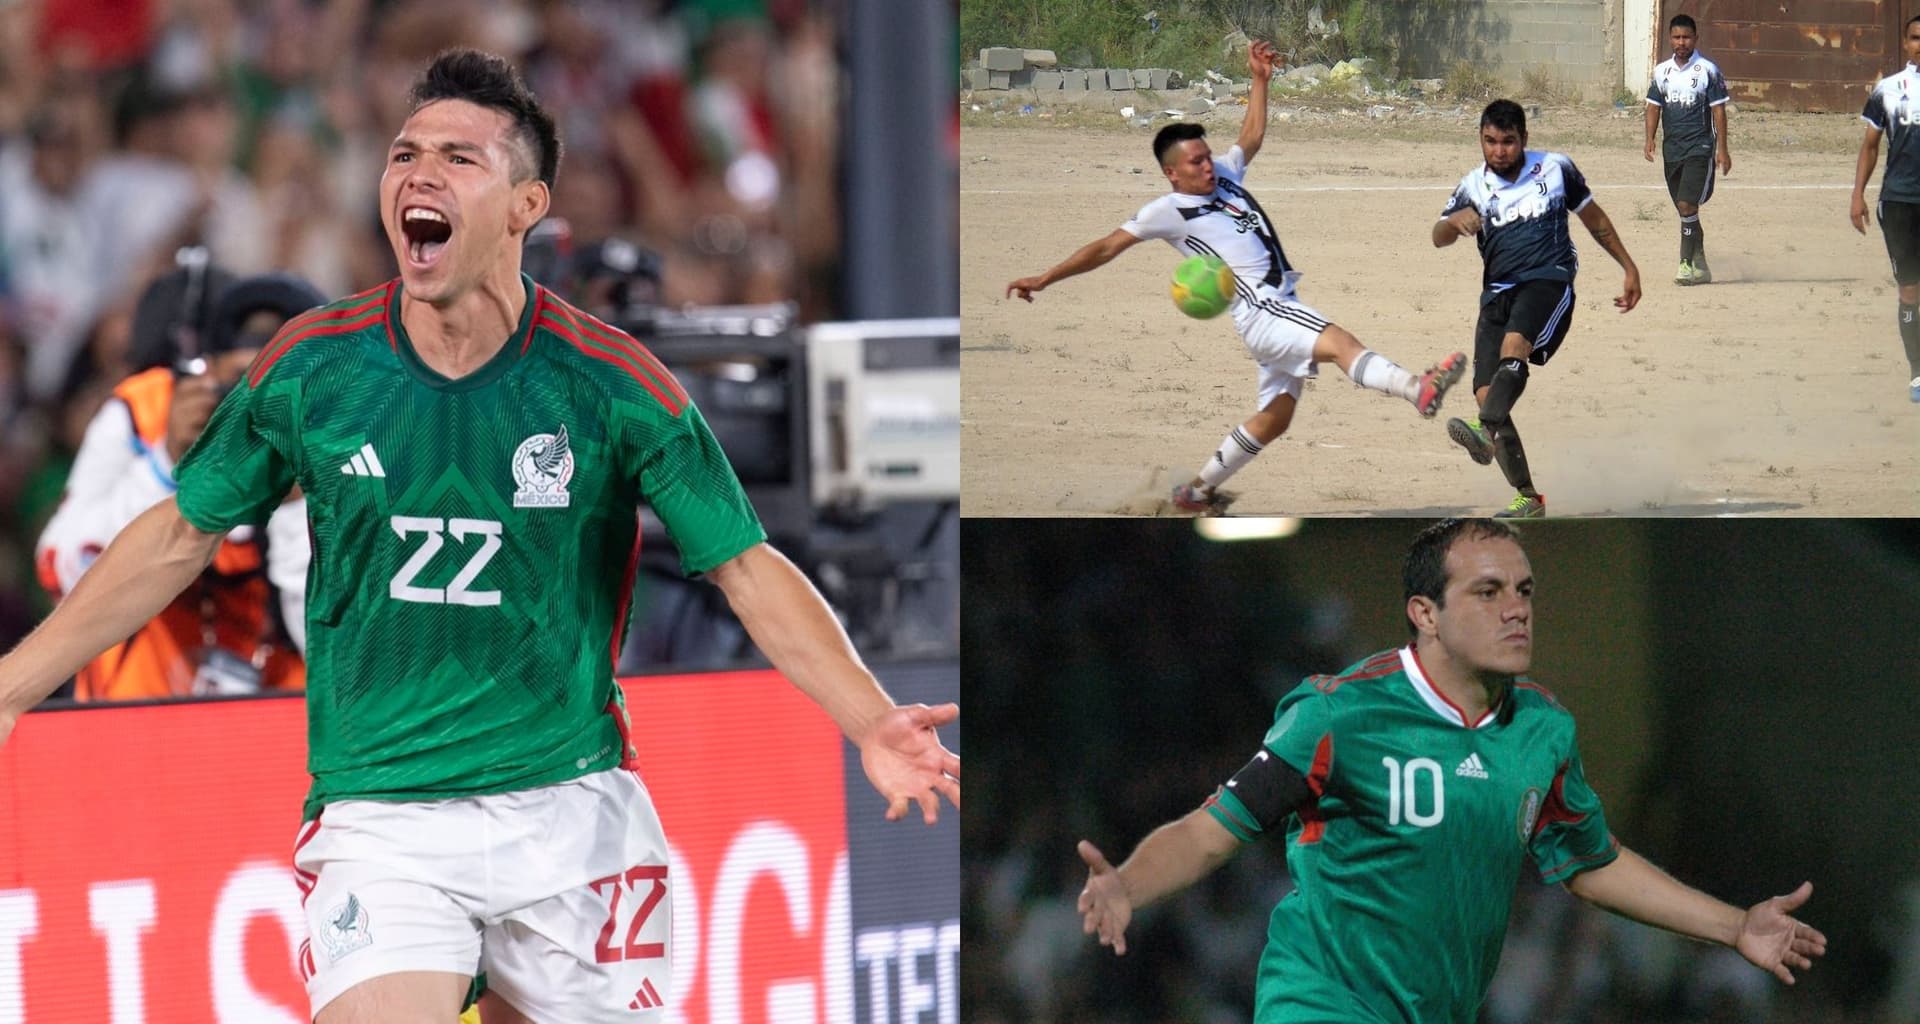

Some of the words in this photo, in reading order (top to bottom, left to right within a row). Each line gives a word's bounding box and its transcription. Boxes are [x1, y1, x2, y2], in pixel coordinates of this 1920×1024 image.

[1491, 198, 1550, 227] Jeep
[389, 515, 503, 607] 22
[1382, 756, 1444, 828] 10
[1455, 767, 1489, 780] adidas
[588, 865, 668, 964] 22
